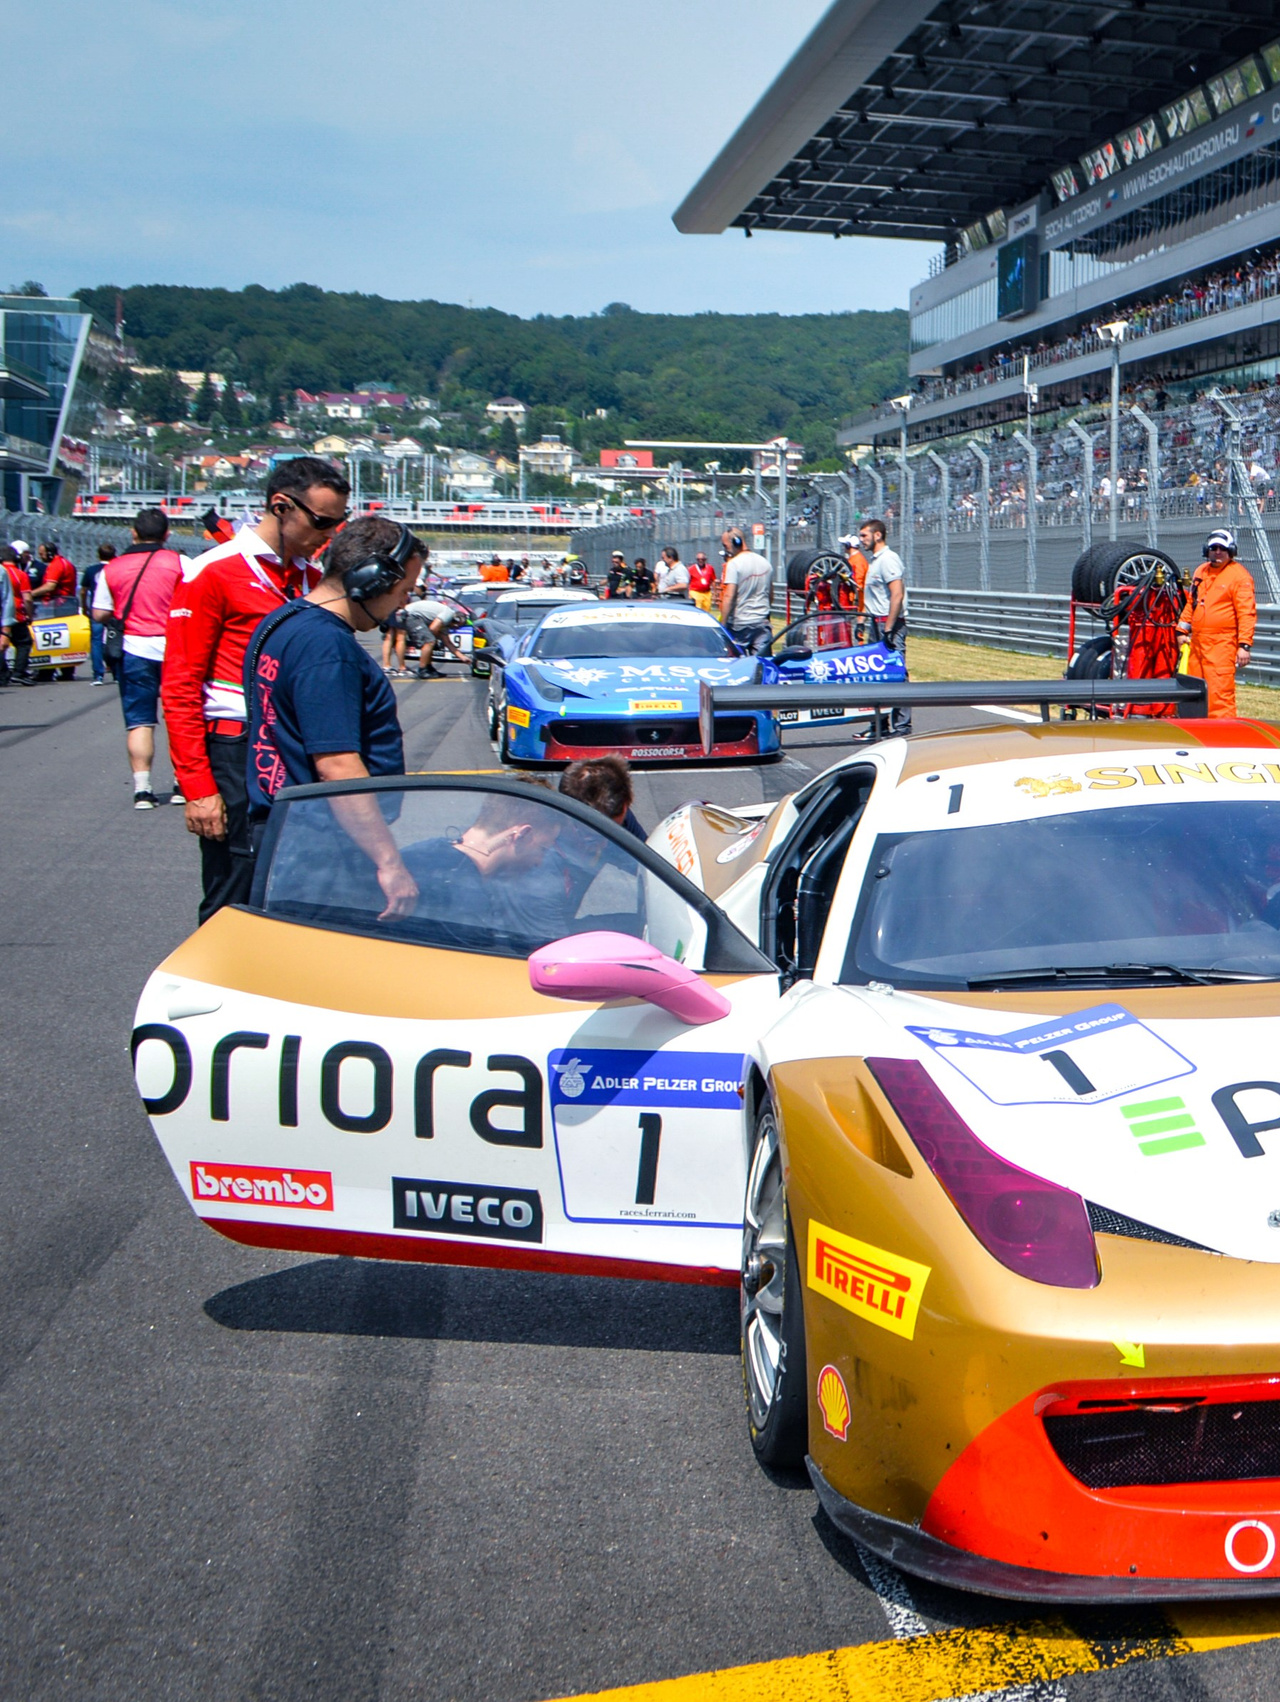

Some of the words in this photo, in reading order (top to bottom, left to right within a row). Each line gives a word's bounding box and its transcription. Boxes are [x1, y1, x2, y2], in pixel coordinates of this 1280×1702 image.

[1122, 123, 1240, 200] WWW.SOCHIAUTODROM.RU
[1045, 218, 1064, 240] SOCHI
[1064, 197, 1101, 229] AUTODROM
[42, 631, 62, 647] 92
[618, 665, 731, 680] MSC
[831, 654, 886, 675] MSC
[836, 673, 889, 684] CRUISES
[631, 748, 684, 757] ROSSOCORSA
[947, 783, 964, 814] 1
[965, 1037, 1014, 1048] ADLER
[1014, 1028, 1074, 1048] PELZER
[1074, 1013, 1126, 1031] GROUP
[591, 1076, 638, 1089] ADLER
[643, 1077, 697, 1091] PELZER
[702, 1079, 744, 1093] GROU
[1039, 1050, 1097, 1095] 1
[635, 1112, 662, 1205] 1
[195, 1168, 328, 1206] brembo
[404, 1189, 534, 1228] IVECO
[619, 1208, 697, 1219] races.ferrari.com
[816, 1238, 911, 1320] PIRELLI
